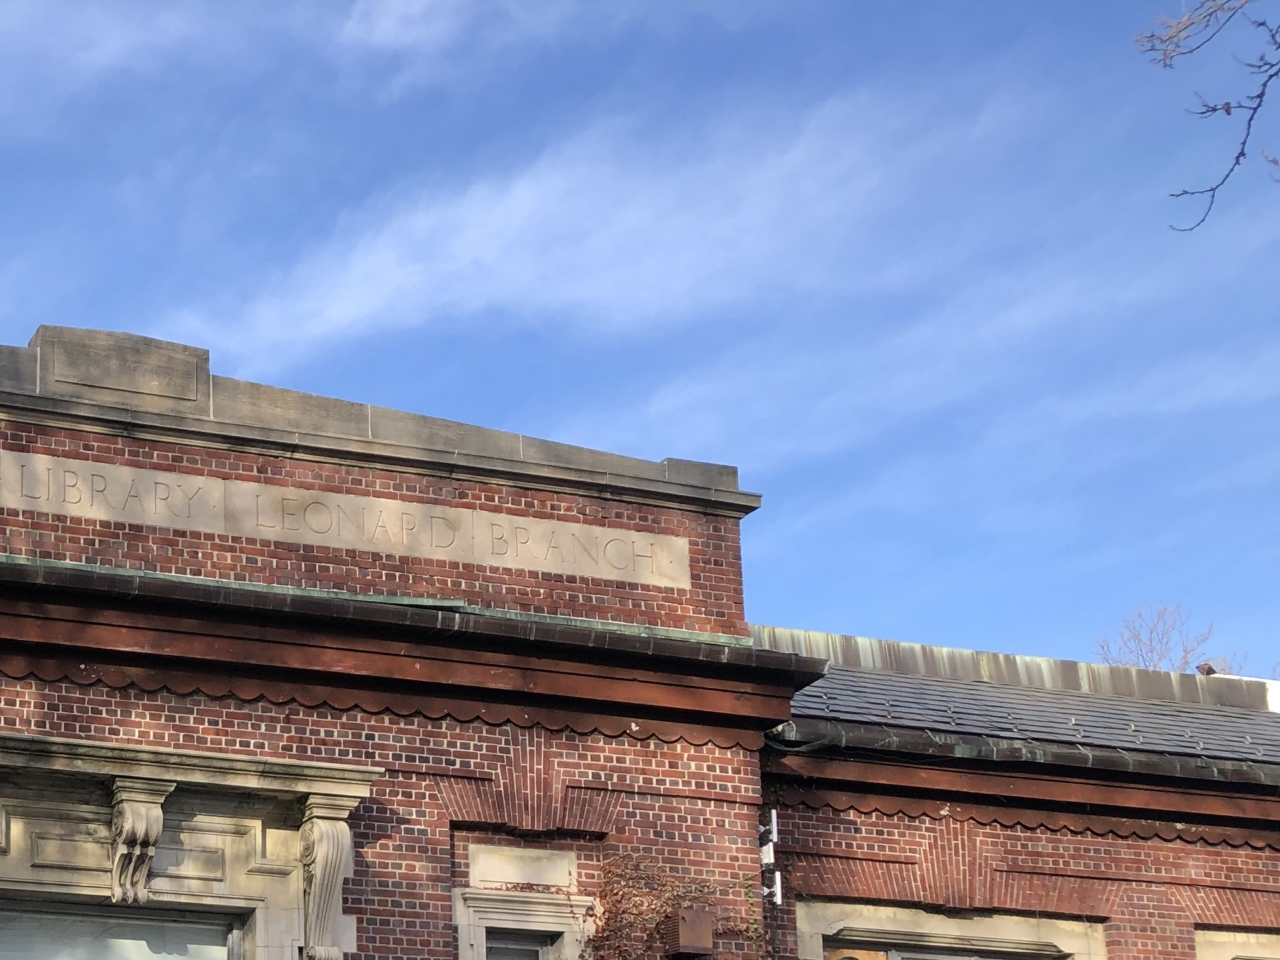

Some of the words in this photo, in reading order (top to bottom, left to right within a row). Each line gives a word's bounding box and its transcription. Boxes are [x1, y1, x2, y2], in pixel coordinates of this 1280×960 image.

[19, 464, 204, 519] LIBRARY
[253, 494, 457, 549] LEONARD
[489, 522, 656, 574] BRANCH
